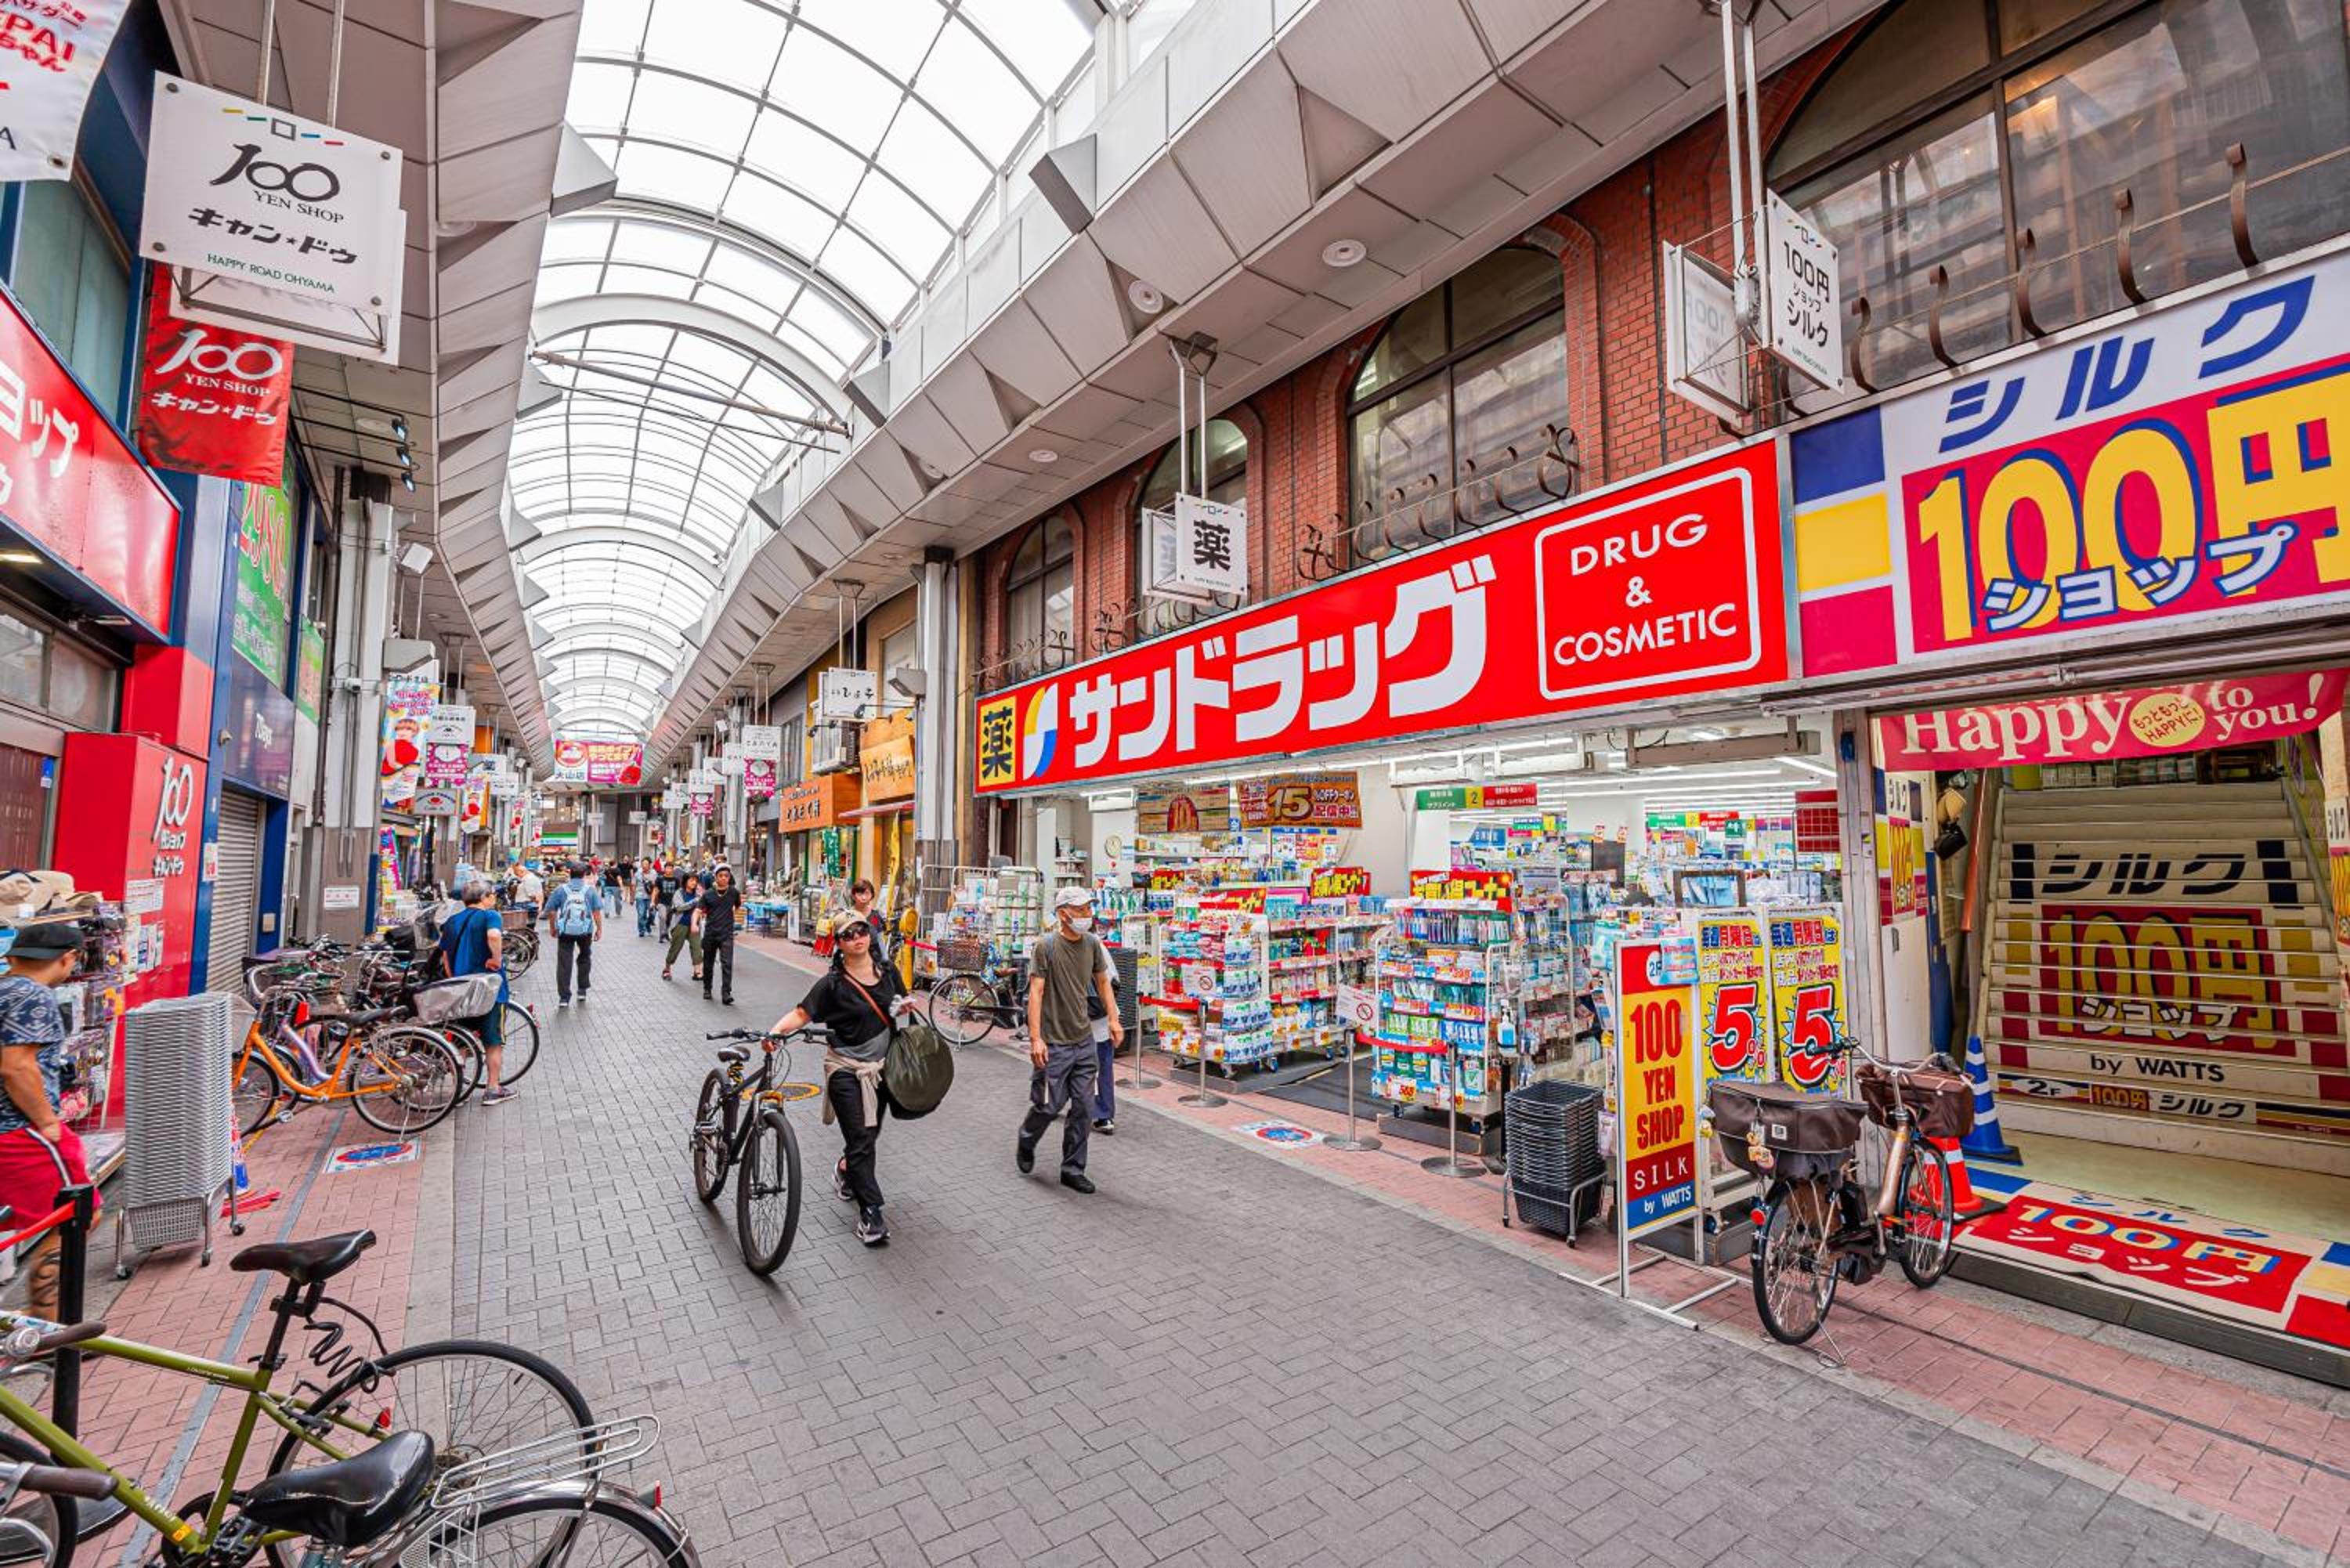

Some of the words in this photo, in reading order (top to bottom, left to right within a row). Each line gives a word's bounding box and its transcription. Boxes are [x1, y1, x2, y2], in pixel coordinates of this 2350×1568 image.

[0, 10, 77, 62] PAI
[210, 144, 340, 202] 100
[254, 190, 293, 211] YEN
[297, 203, 345, 225] SHOP
[208, 254, 246, 272] HAPPY
[249, 264, 282, 280] ROAD
[284, 274, 335, 294] OHYAMA
[1784, 240, 1830, 303] 100円
[1788, 299, 1828, 348] シルク
[156, 329, 283, 380] 100
[1939, 275, 2316, 453] シルク
[184, 373, 220, 388] YEN
[223, 381, 271, 398] SHOP
[1918, 364, 2350, 641] 100円
[1193, 520, 1231, 573] 薬
[1571, 513, 1708, 576] DRUG
[1625, 576, 1653, 607] &
[1981, 521, 2299, 633] ショップ
[1553, 602, 1737, 666] COSMETIC
[1069, 554, 1497, 769] サンドラッグ
[2209, 685, 2254, 711] to
[982, 706, 1013, 779] 薬
[1901, 695, 2131, 761] Happy
[1471, 792, 1478, 804] 2
[2041, 854, 2246, 894] シルク
[2049, 912, 2278, 1050] 100円
[1629, 999, 1683, 1064] 100
[2081, 996, 2239, 1042] ショップ
[1643, 1066, 1676, 1105] YEN
[2028, 1080, 2061, 1096] 2F
[2091, 1055, 2123, 1075] by
[2135, 1057, 2225, 1082] WATTS
[1636, 1104, 1684, 1151] SHOP
[2159, 1094, 2246, 1118] シルク
[1634, 1155, 1689, 1190] SILK
[1644, 1200, 1655, 1214] by
[1661, 1184, 1692, 1210] WATTS
[2070, 1194, 2270, 1240] シルク
[2007, 1227, 2251, 1288] ショップ
[2018, 1205, 2282, 1274] 100円
